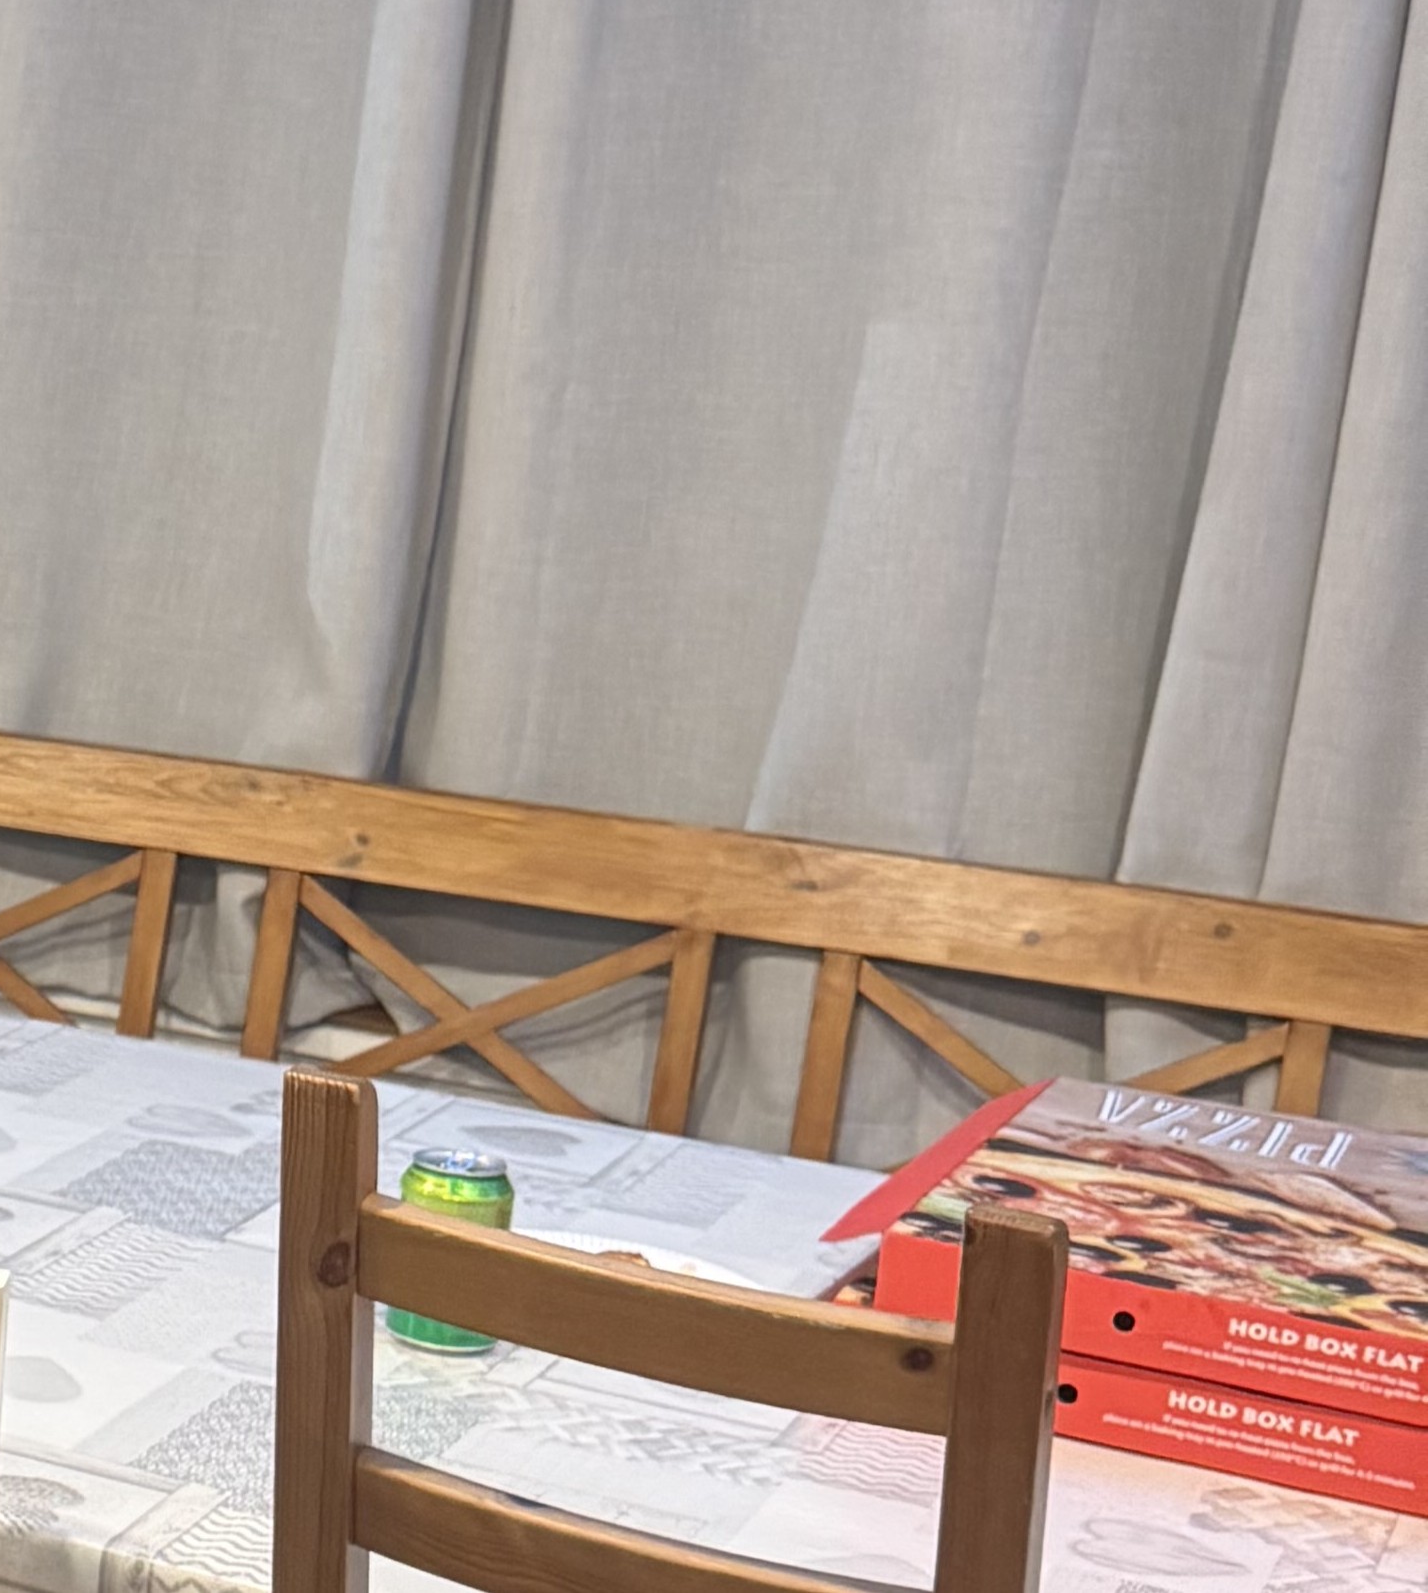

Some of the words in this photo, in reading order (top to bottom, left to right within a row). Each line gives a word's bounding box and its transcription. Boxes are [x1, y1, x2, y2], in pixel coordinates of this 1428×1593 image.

[1096, 1088, 1354, 1171] PIZZA
[1228, 1317, 1300, 1347] HOLD
[1303, 1333, 1359, 1360] BOX
[1362, 1345, 1425, 1374] FLAT
[1167, 1389, 1238, 1419] HOLD
[1241, 1407, 1295, 1434] BOX
[1299, 1419, 1361, 1448] FLAT
